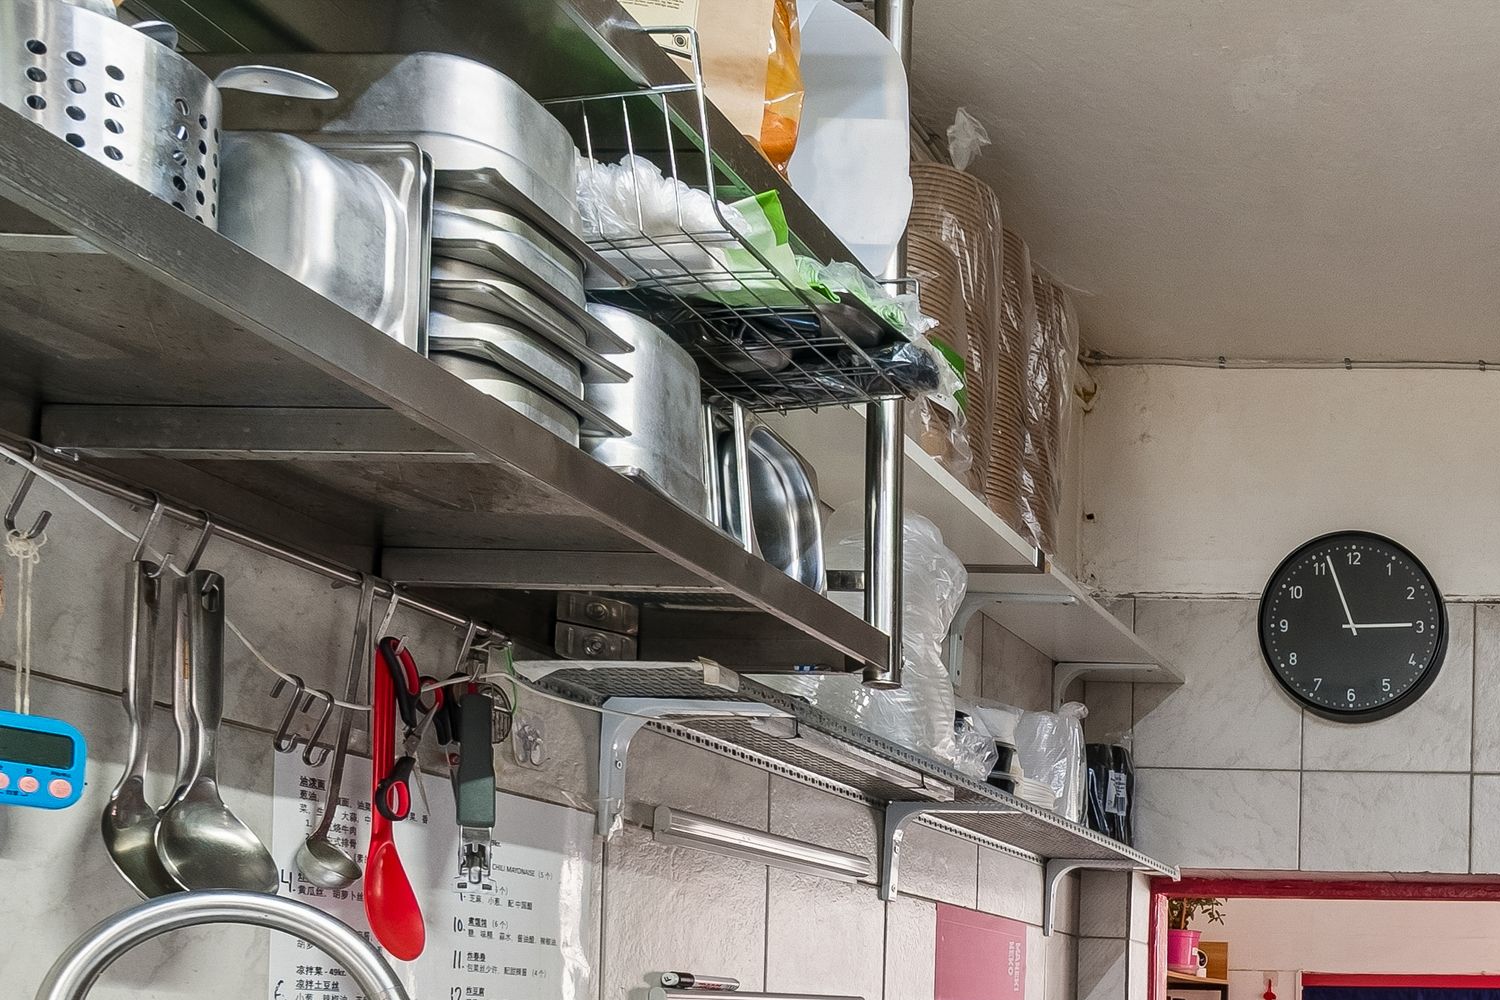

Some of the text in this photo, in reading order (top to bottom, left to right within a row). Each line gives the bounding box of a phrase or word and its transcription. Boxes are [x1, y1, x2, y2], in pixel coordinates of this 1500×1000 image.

[1347, 552, 1361, 565] 12
[1313, 562, 1326, 576] 11
[1386, 563, 1392, 576] 1
[1289, 586, 1303, 599] 10
[1406, 587, 1415, 600] 2
[1280, 619, 1288, 633] 9
[1415, 620, 1424, 633] 3
[1289, 653, 1297, 665] 8
[1408, 653, 1416, 666] 4
[1313, 678, 1322, 691] 7
[1382, 679, 1391, 691] 5
[1347, 689, 1356, 702] 6
[296, 965, 324, 976] 凉拌菜
[295, 979, 340, 992] 凉拌土豆丝
